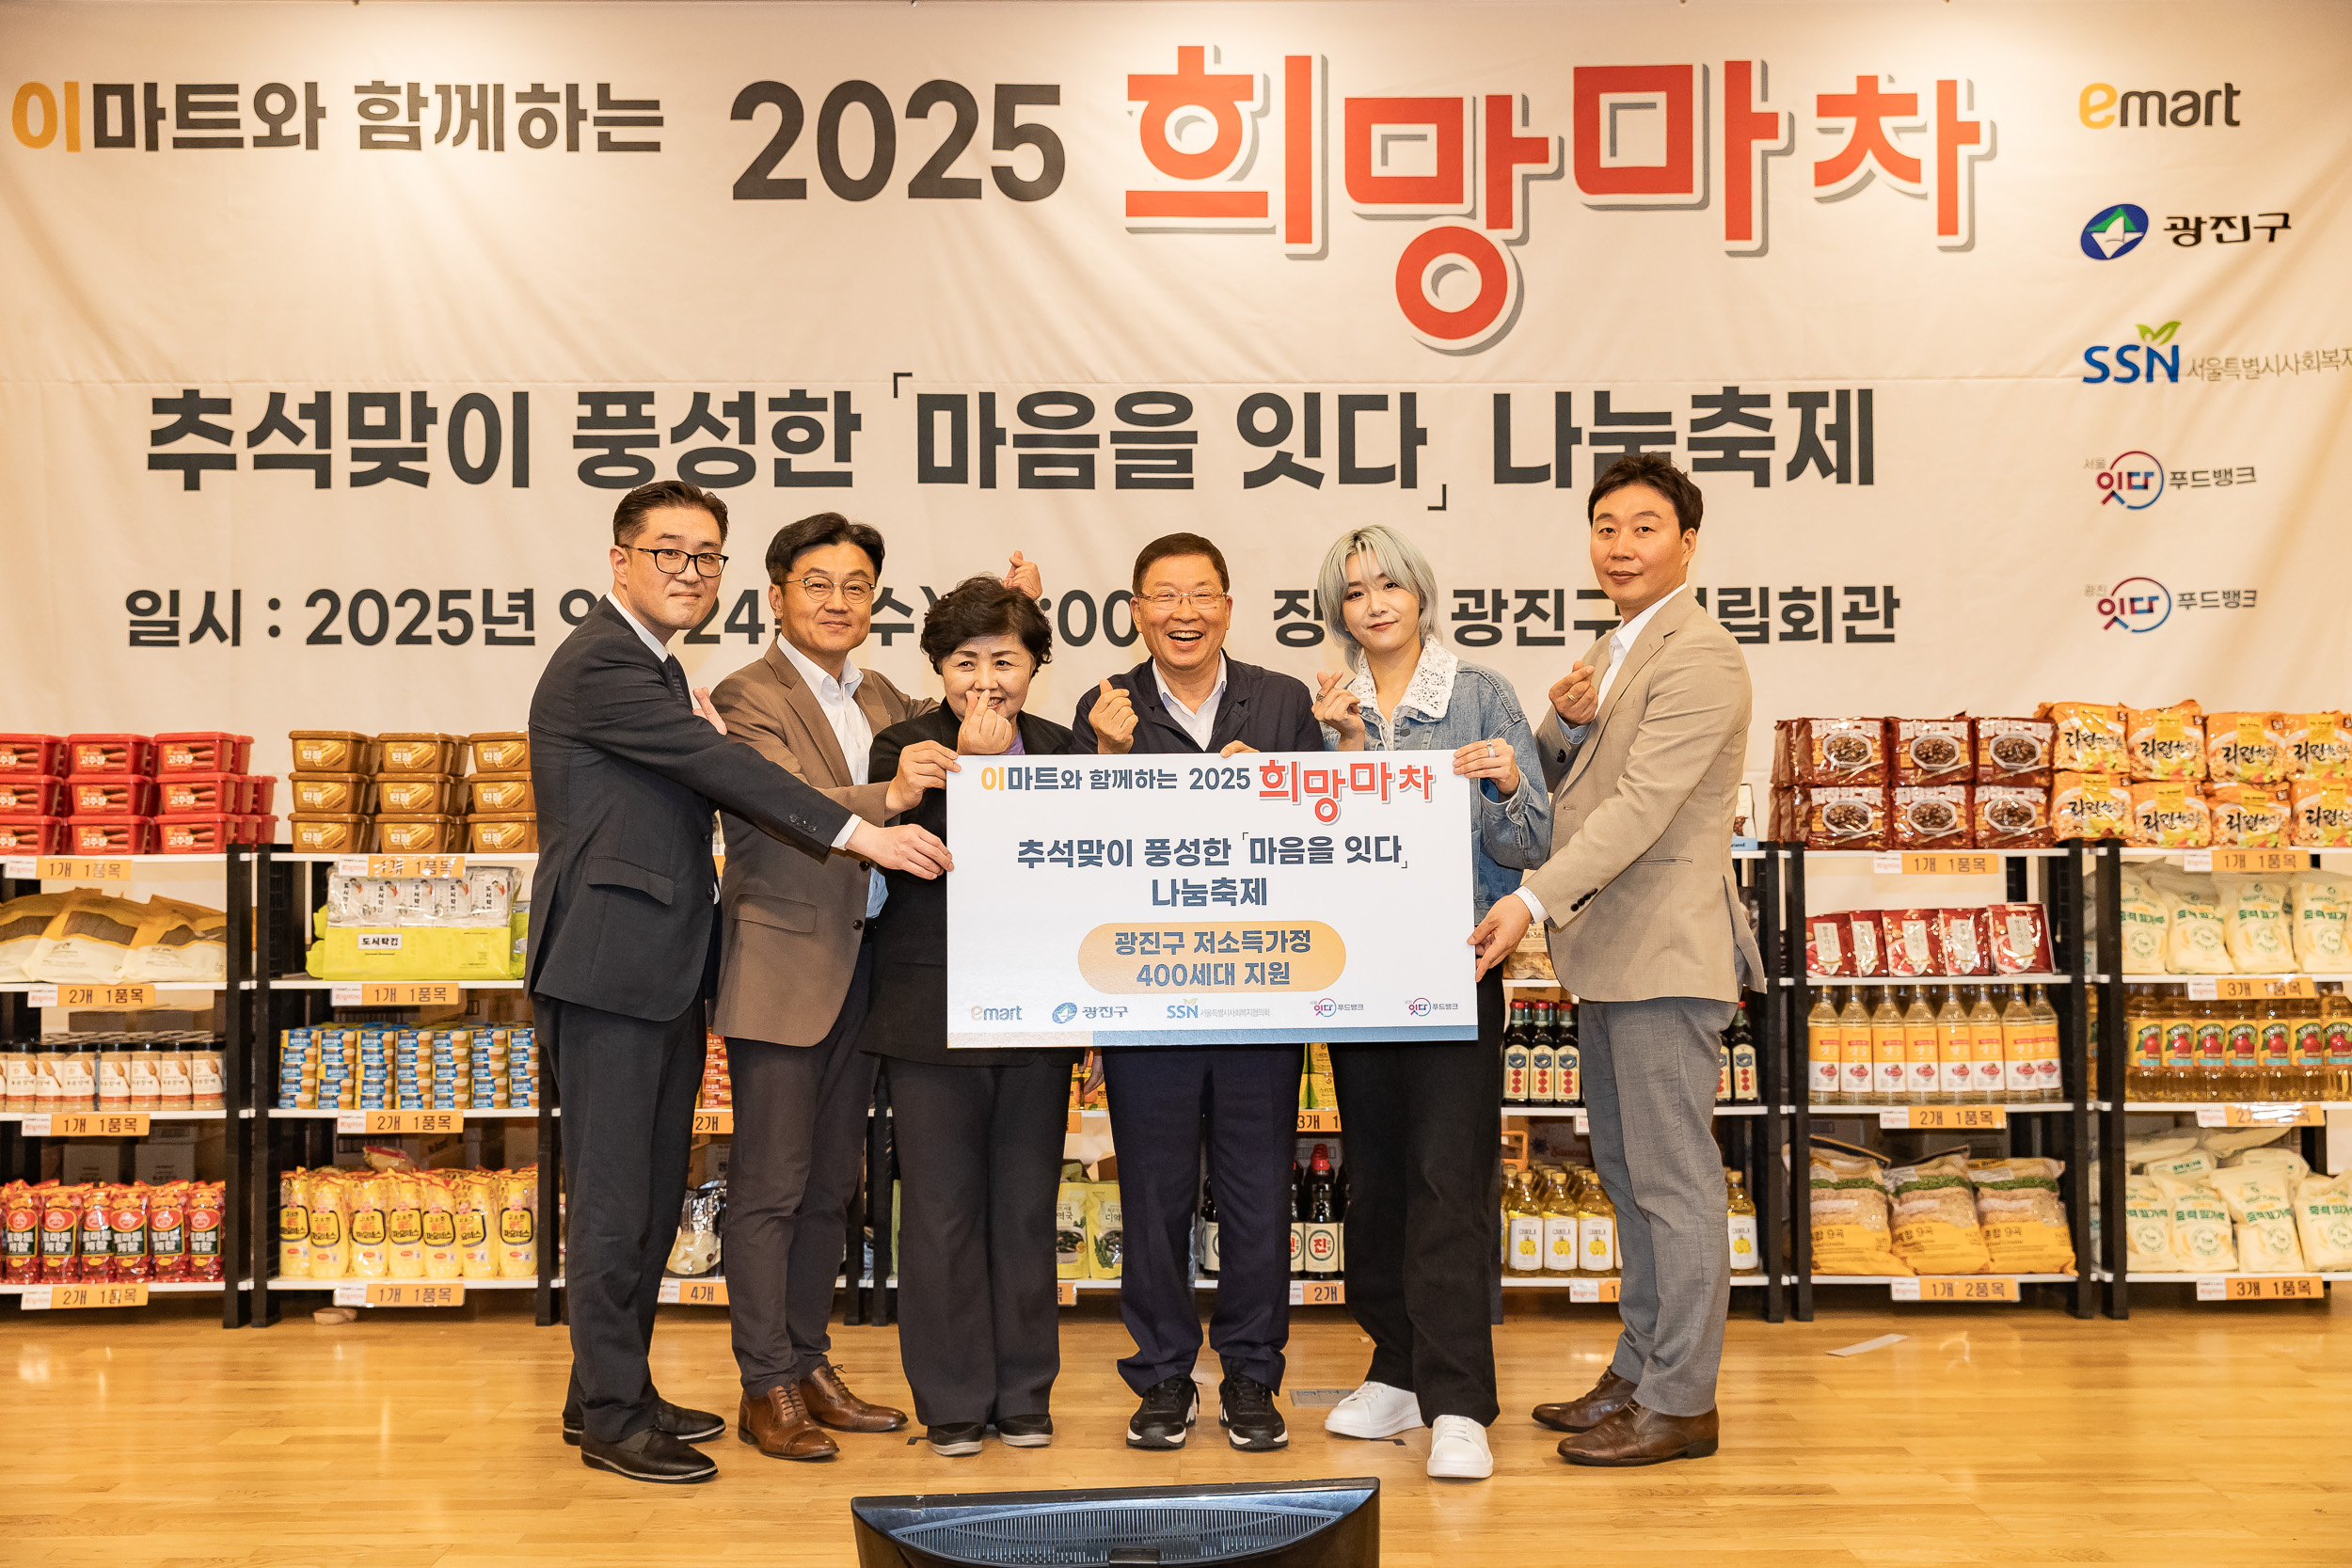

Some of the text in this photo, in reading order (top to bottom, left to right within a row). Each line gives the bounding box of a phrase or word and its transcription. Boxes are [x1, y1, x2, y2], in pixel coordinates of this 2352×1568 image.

[2079, 82, 2241, 130] emart
[11, 45, 1996, 356] 이마트와 함께하는 2025 희망마차
[2164, 213, 2292, 247] 광진구
[2082, 344, 2180, 384] SSN
[148, 389, 532, 491] 추석맞이
[572, 388, 863, 490] 풍성한
[1493, 387, 1874, 487] 나눔축제
[2169, 467, 2256, 489] 푸드뱅크
[2178, 590, 2257, 610] 푸드뱅크
[125, 589, 242, 648] 일시
[305, 588, 536, 646] 2025년
[1695, 585, 1900, 646] 립회관
[0, 754, 16, 766] 추장
[980, 759, 1436, 824] 이마트와 함께하는 2025 희망마차
[0, 796, 16, 806] 추장
[0, 836, 16, 847] 추장
[1017, 838, 1134, 869] 추석맞이
[1144, 836, 1232, 867] 풍성한
[1151, 877, 1267, 908] 나눔축제
[1114, 929, 1311, 955] 광진구 저소득가정
[1136, 960, 1291, 988] 400세대 지원
[70, 989, 92, 1004] 2개
[106, 989, 143, 1004] 1품목
[375, 987, 396, 1002] 1개
[411, 987, 446, 1003] 1품목
[971, 1006, 1023, 1022] emart
[1082, 1006, 1129, 1019] 광진구
[1167, 1005, 1199, 1019] SSN
[64, 1117, 86, 1132] 1개
[100, 1117, 137, 1132] 1품목
[377, 1116, 401, 1131] 2개
[414, 1115, 451, 1131] 1품목
[695, 1117, 719, 1132] 2개
[691, 1285, 714, 1301] 4개
[1315, 1286, 1338, 1301] 2개
[2237, 1282, 2260, 1297] 3개
